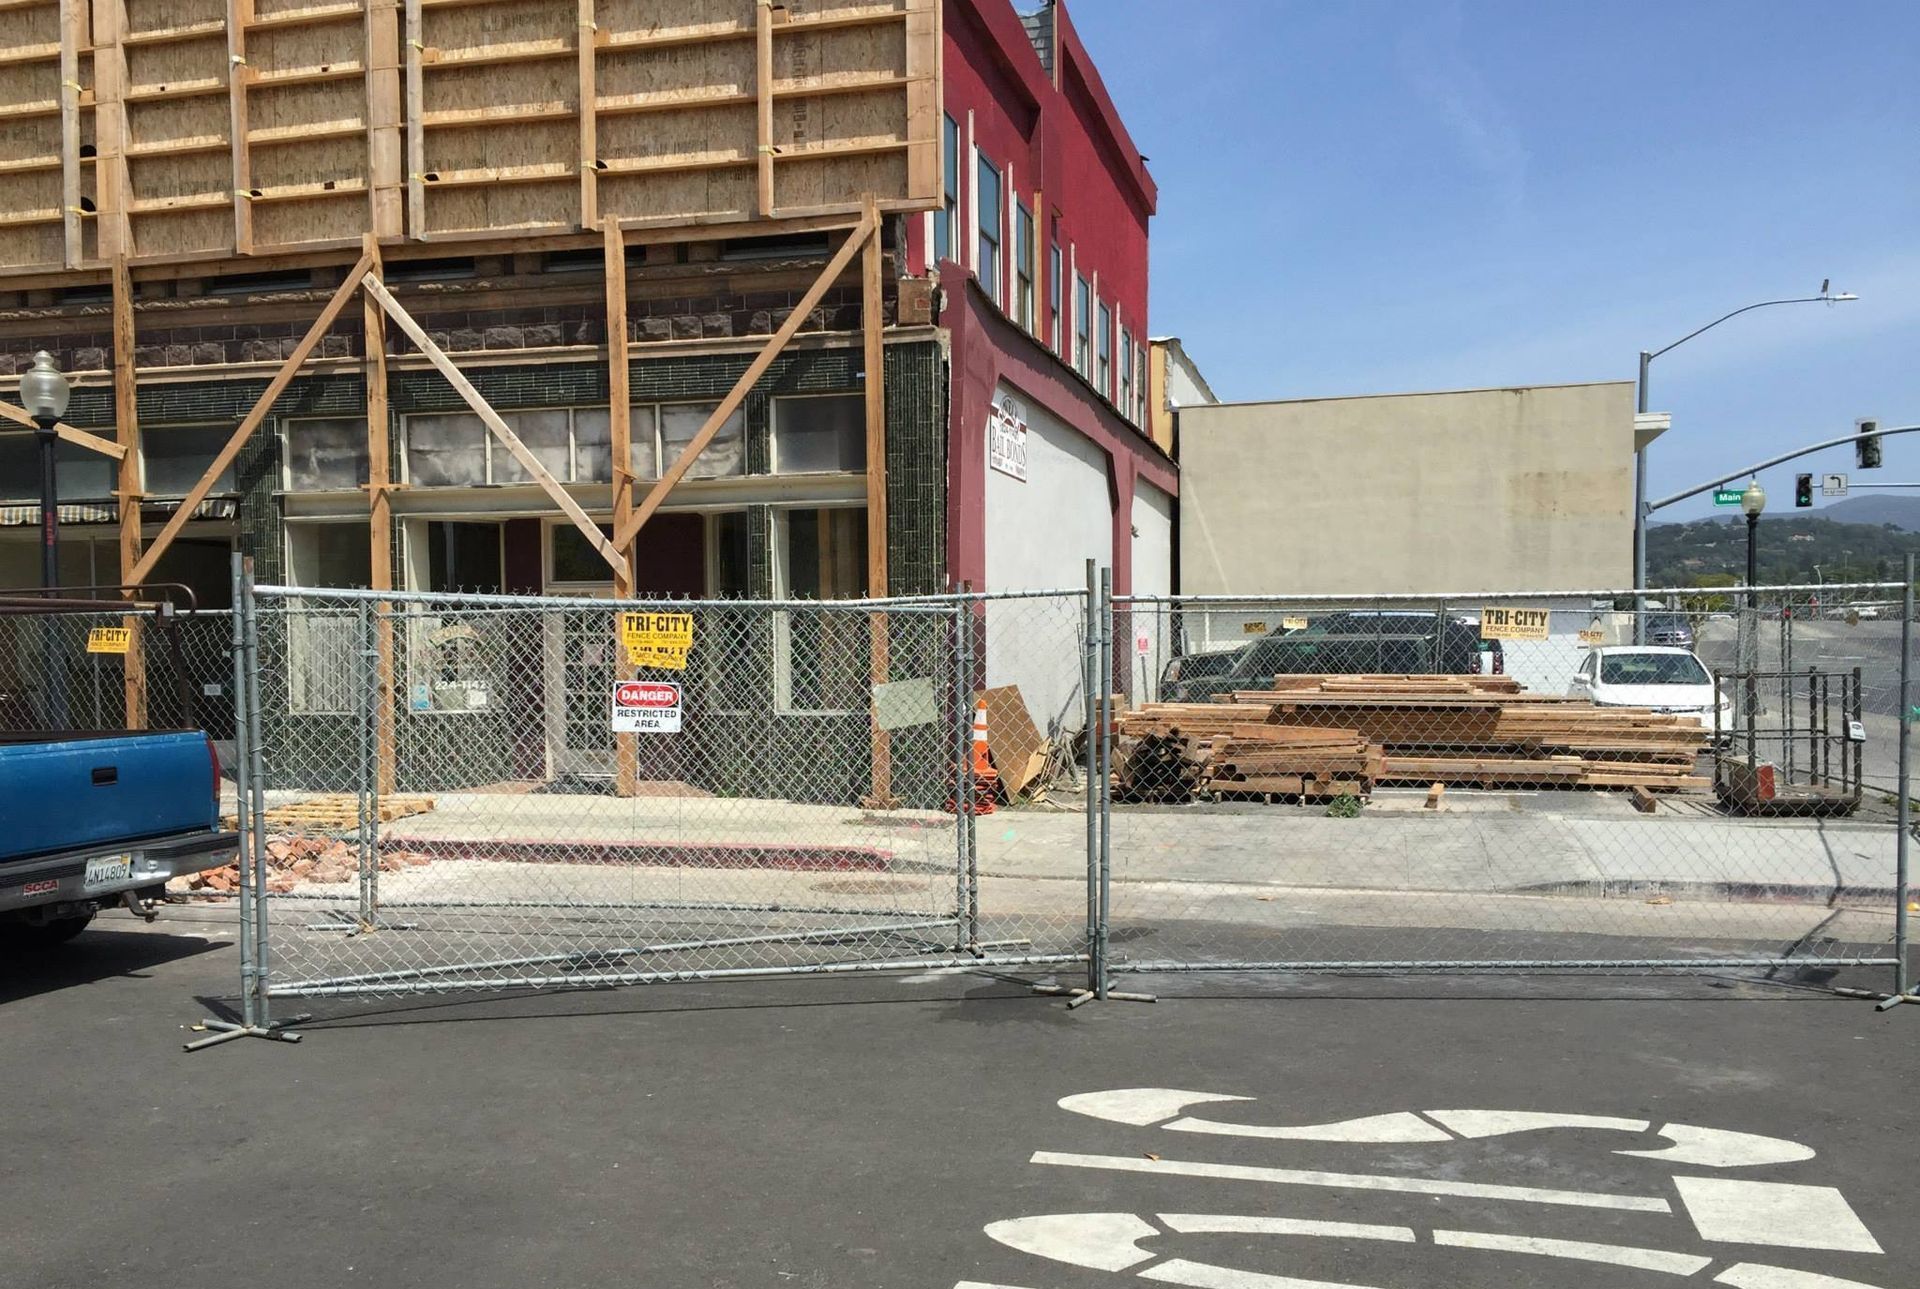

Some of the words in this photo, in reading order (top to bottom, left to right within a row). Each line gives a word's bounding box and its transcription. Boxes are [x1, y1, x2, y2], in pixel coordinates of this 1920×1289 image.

[1719, 493, 1742, 502] Main
[1485, 609, 1547, 627] TRI-CITY
[625, 615, 690, 632] TRI-CITY
[1485, 625, 1508, 633] FENCE
[1510, 626, 1545, 634] COMPANY
[91, 629, 128, 642] TRI-CITY
[626, 632, 651, 640] FENCE
[652, 632, 688, 640] COMPANY
[621, 690, 674, 702] DANGER
[617, 709, 677, 718] RESTRICTED
[634, 720, 661, 728] AREA
[24, 880, 58, 893] SCCA
